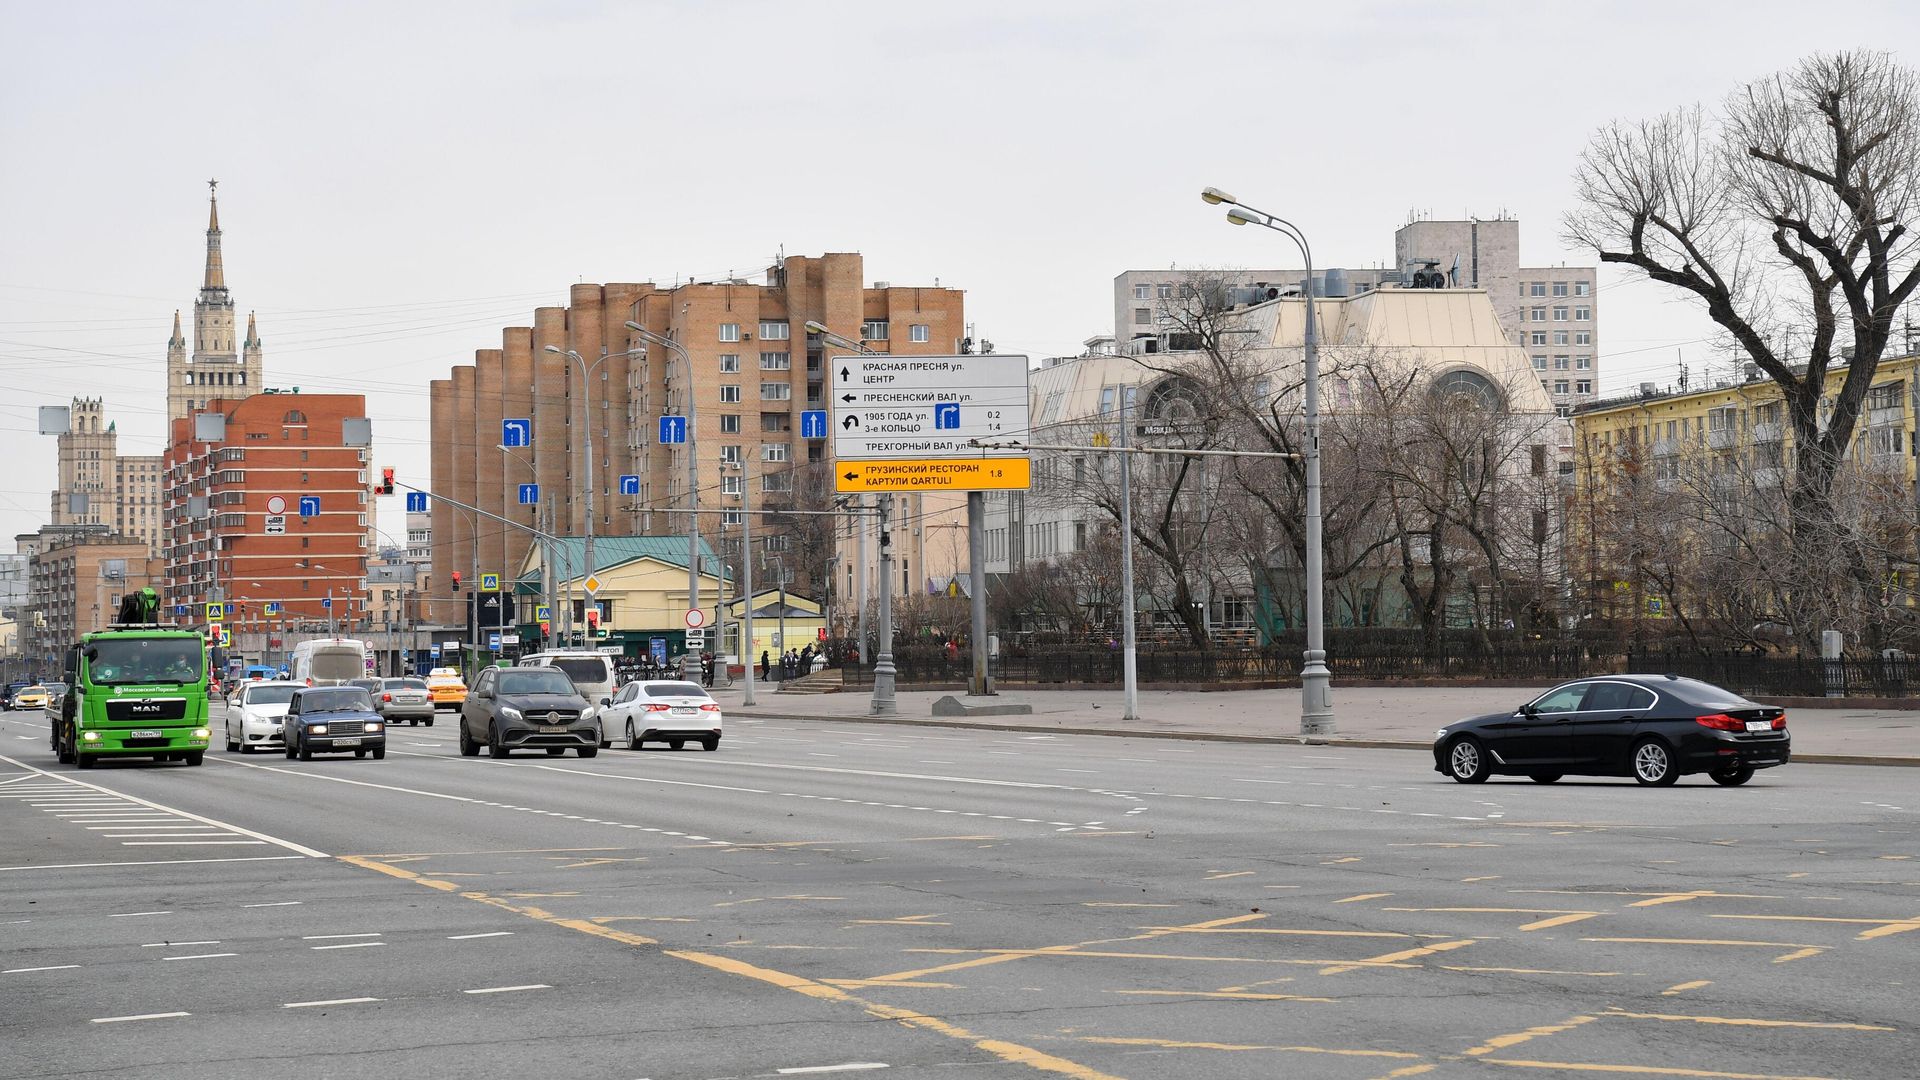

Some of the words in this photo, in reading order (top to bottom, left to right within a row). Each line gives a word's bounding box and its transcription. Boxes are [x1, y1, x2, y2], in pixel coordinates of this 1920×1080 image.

[862, 363, 907, 371] КРАСНАЯ
[909, 362, 949, 371] ПРЕСНЯ
[951, 363, 965, 372] ул.
[863, 375, 895, 384] ЦЕНТР
[863, 392, 935, 402] ПРЕСНЕНСКИЙ
[937, 393, 957, 401] ВАЛ
[959, 394, 973, 402] ул.
[887, 413, 913, 421] ГОДА
[915, 414, 929, 422] ул.
[987, 411, 1001, 419] 0.2
[865, 425, 878, 433] 3-е
[881, 424, 921, 433] КОЛЬЦО
[988, 423, 1001, 431] 1.4
[865, 441, 933, 451] ТРЕХГОРНЫЙ
[933, 442, 953, 450] ВАЛ
[865, 464, 927, 474] ГРУЗИНСКИЙ
[929, 465, 979, 473] РЕСТОРАН
[990, 470, 1003, 478] 1.8
[865, 477, 909, 485] КАРТУЛИ
[910, 477, 952, 485] QARTULI
